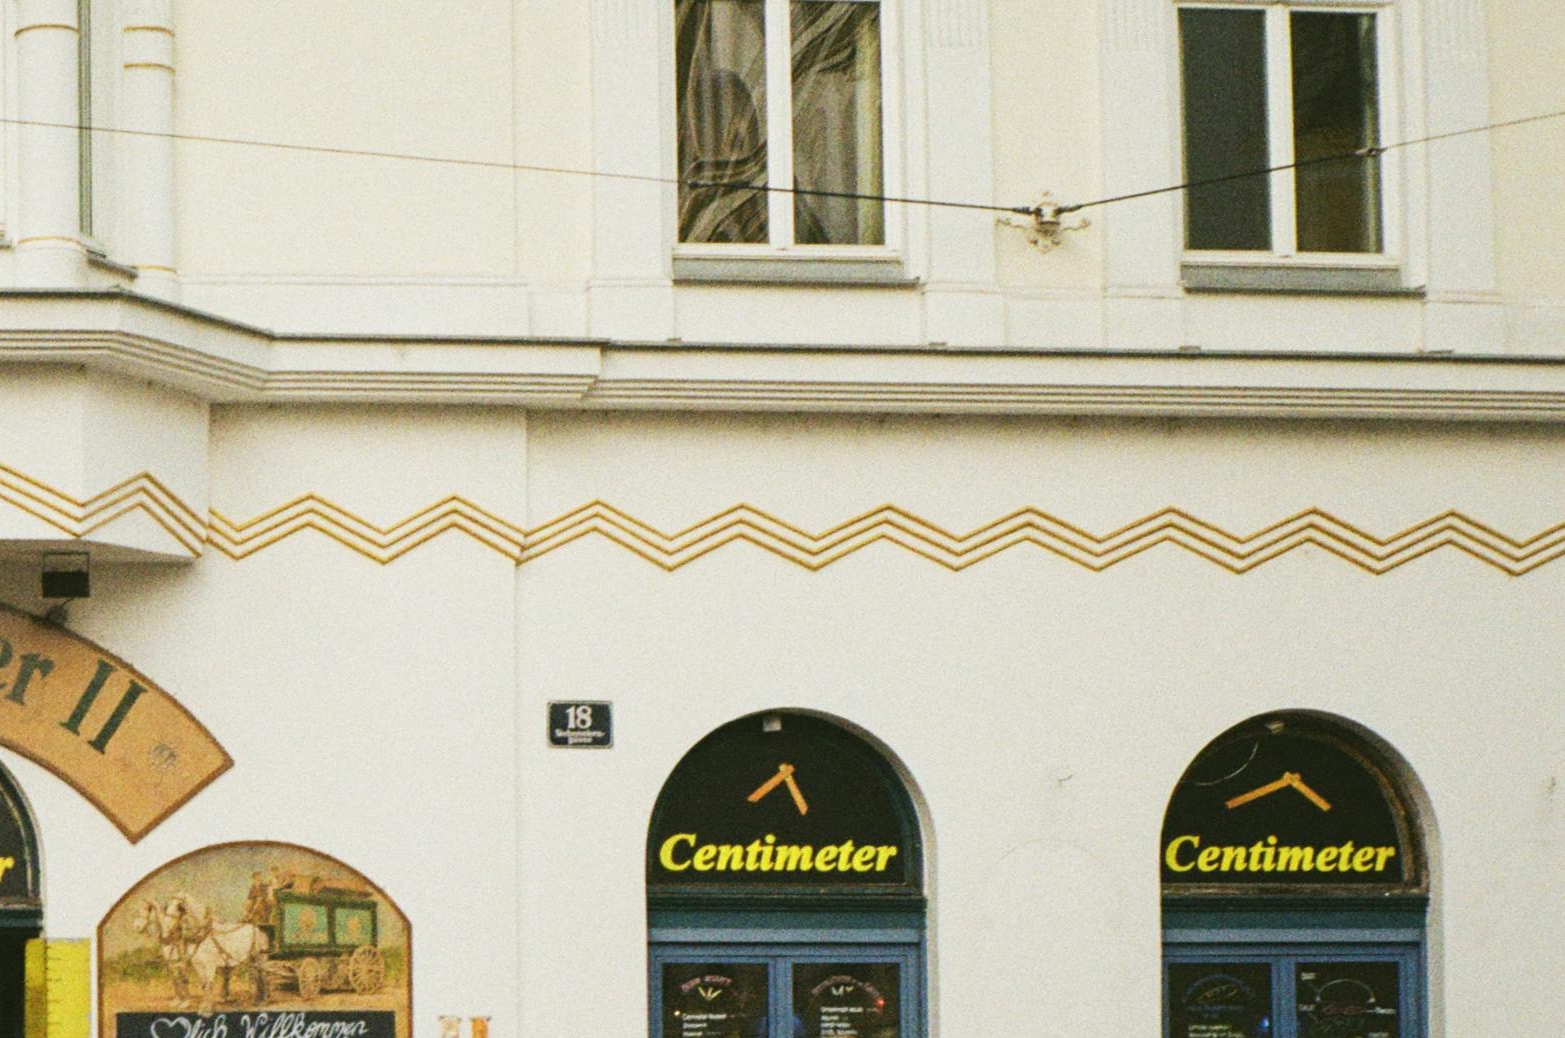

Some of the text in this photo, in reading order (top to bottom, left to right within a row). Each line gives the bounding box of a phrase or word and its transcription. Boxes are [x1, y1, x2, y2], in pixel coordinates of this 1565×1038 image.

[59, 660, 149, 754] II
[565, 705, 593, 730] 18
[659, 833, 898, 872] Centimeter
[1165, 835, 1396, 872] Centimeter
